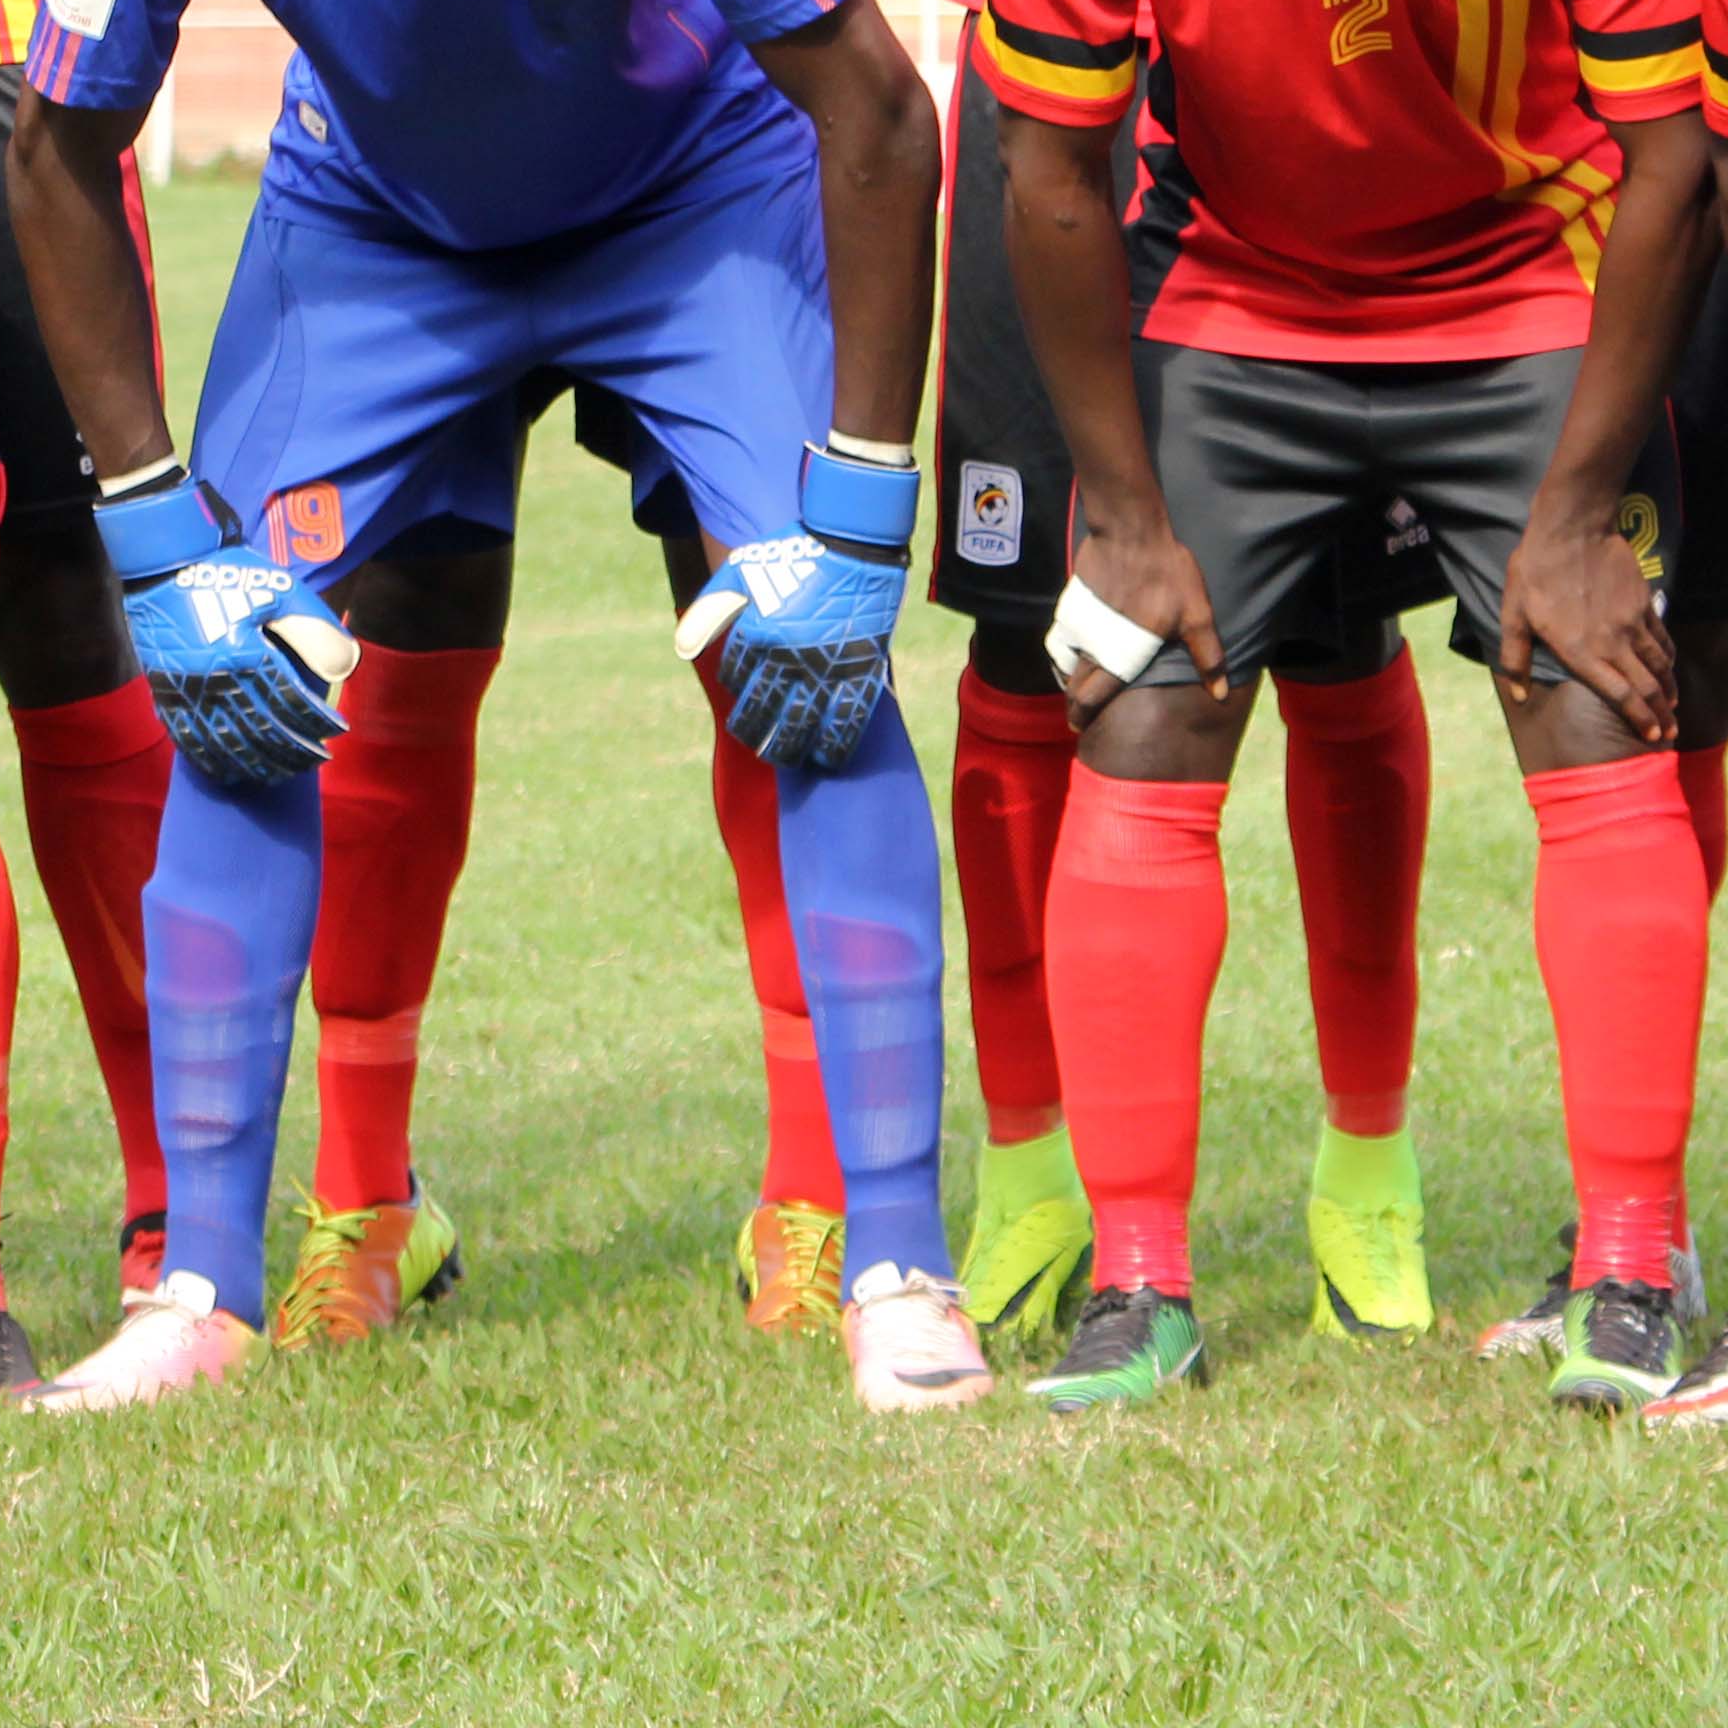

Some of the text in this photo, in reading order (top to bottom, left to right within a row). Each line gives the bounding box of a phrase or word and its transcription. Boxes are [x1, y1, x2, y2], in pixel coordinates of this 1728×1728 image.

[267, 481, 346, 567] 19
[972, 536, 1005, 553] FUFA
[175, 562, 293, 594] adidas
